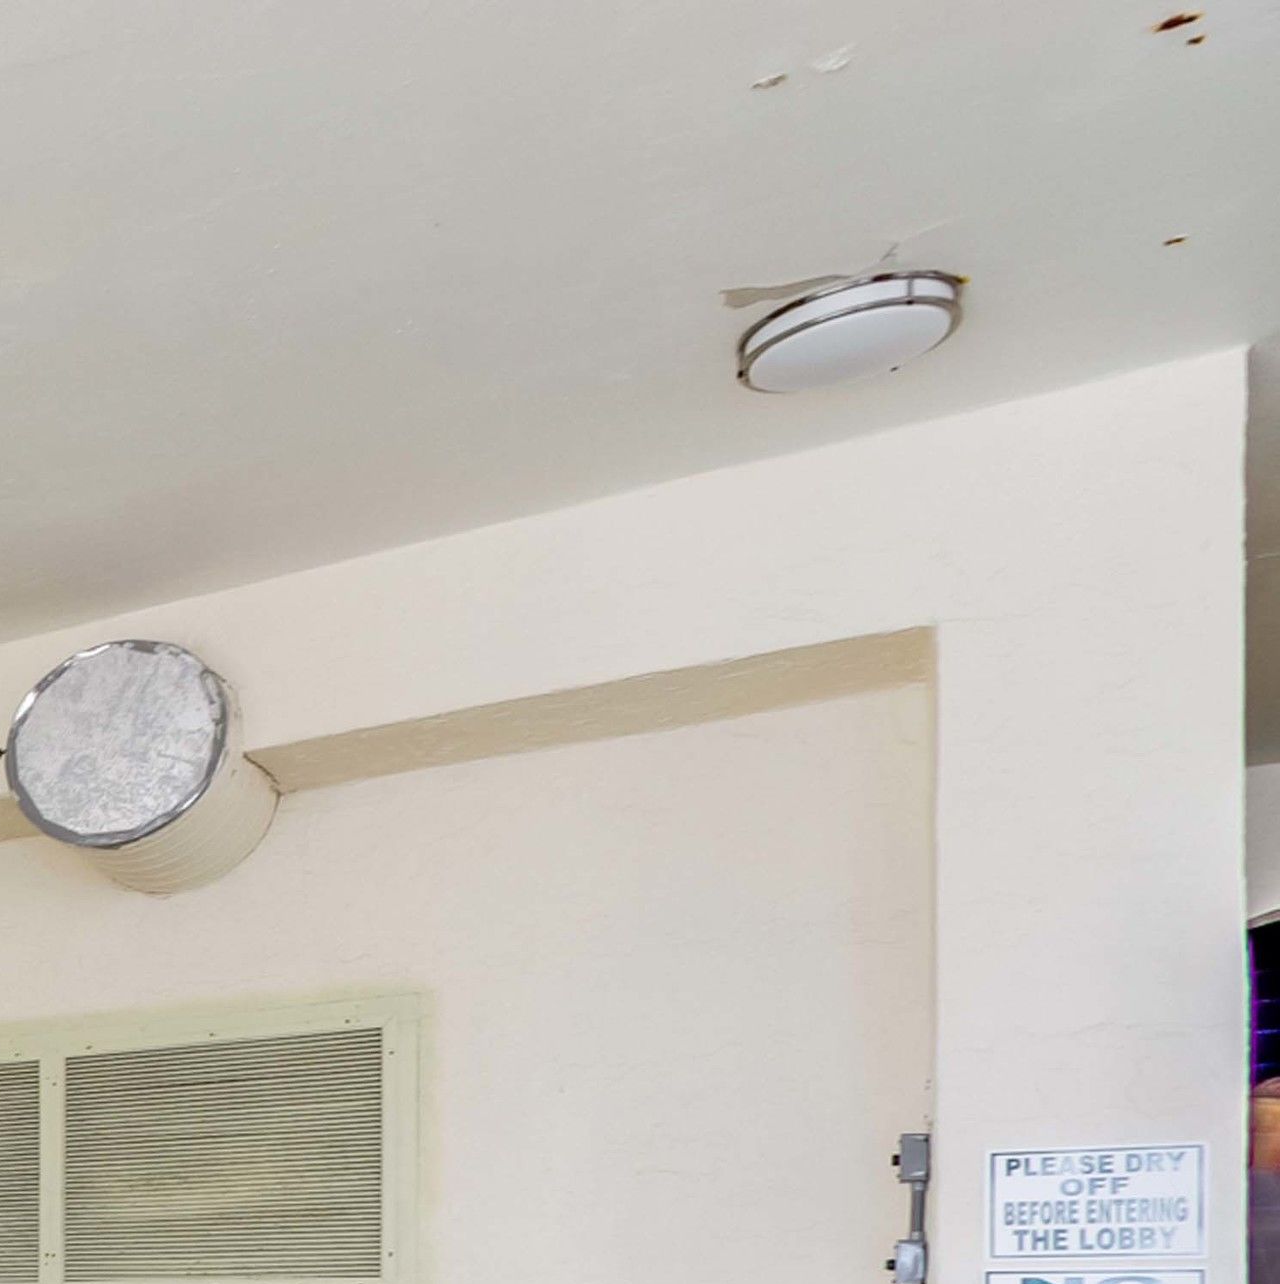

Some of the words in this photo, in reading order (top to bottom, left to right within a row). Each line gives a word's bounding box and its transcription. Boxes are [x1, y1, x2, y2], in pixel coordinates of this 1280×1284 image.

[1005, 1155, 1114, 1176] PLEASE
[1125, 1152, 1186, 1173] DRY
[1060, 1177, 1130, 1196] OFF
[1004, 1200, 1079, 1225] BEFORE
[1086, 1196, 1188, 1223] ENTERING
[1013, 1229, 1069, 1251] THE
[1080, 1227, 1178, 1250] LOBBY
